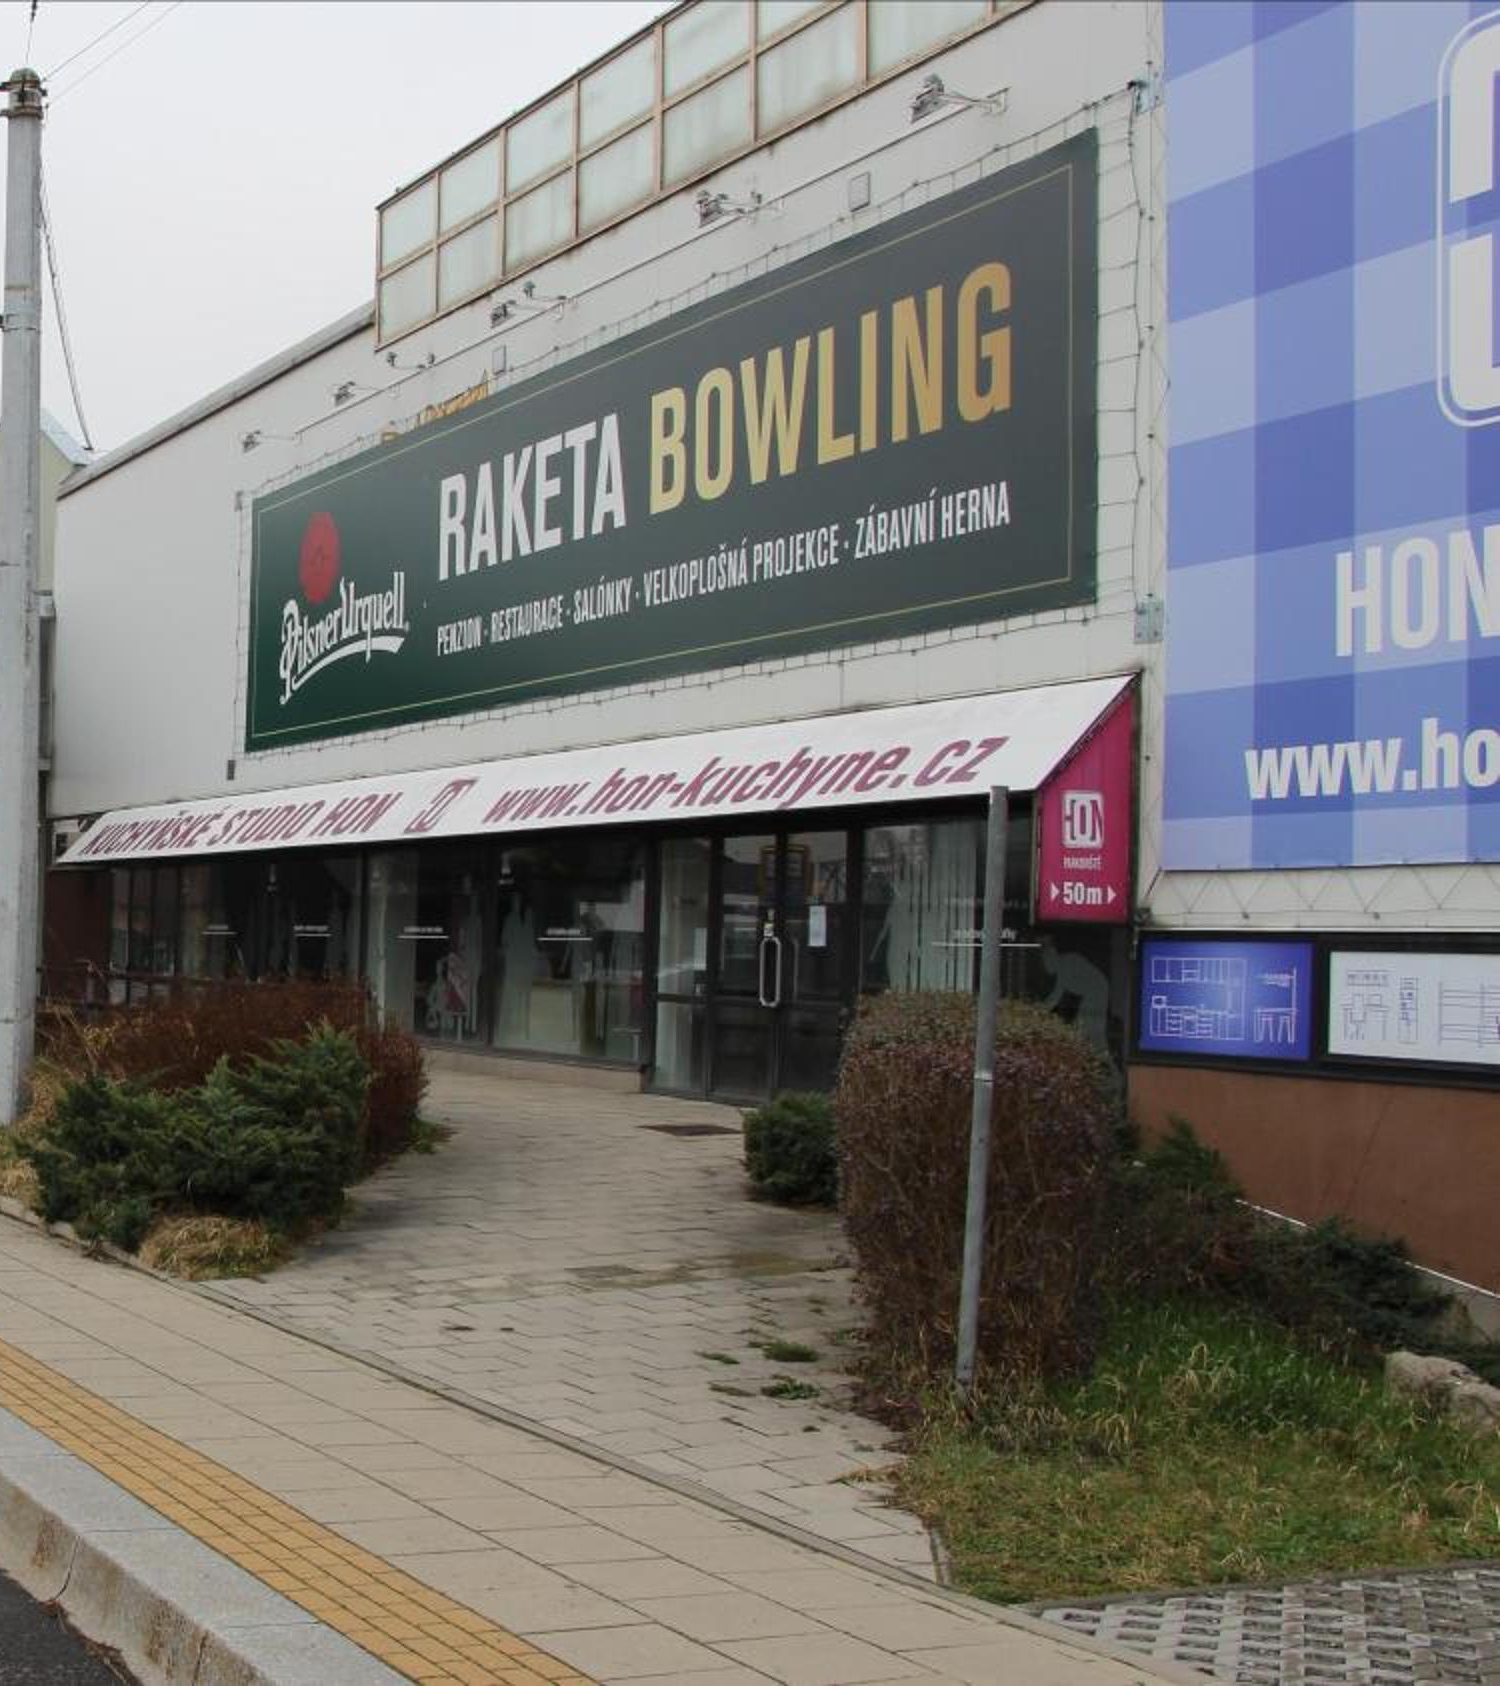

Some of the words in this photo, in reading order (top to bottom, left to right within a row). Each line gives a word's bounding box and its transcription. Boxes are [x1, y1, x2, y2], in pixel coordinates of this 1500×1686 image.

[438, 413, 627, 581] RAKETA
[649, 261, 1012, 515] BOWLING
[437, 615, 483, 657] PENZION
[491, 594, 564, 644] RESTAURACE
[573, 575, 633, 625] SALÓNKY
[644, 537, 749, 607] VELKOPLOŠNÁ
[753, 523, 840, 582] PROJEKCE
[855, 487, 937, 559] ZÁBAVNÍ
[941, 480, 1011, 539] HERNA
[1336, 524, 1500, 657] HON
[206, 799, 327, 847] STUDIO
[482, 735, 1010, 824] www.hon-kuchyne.cz
